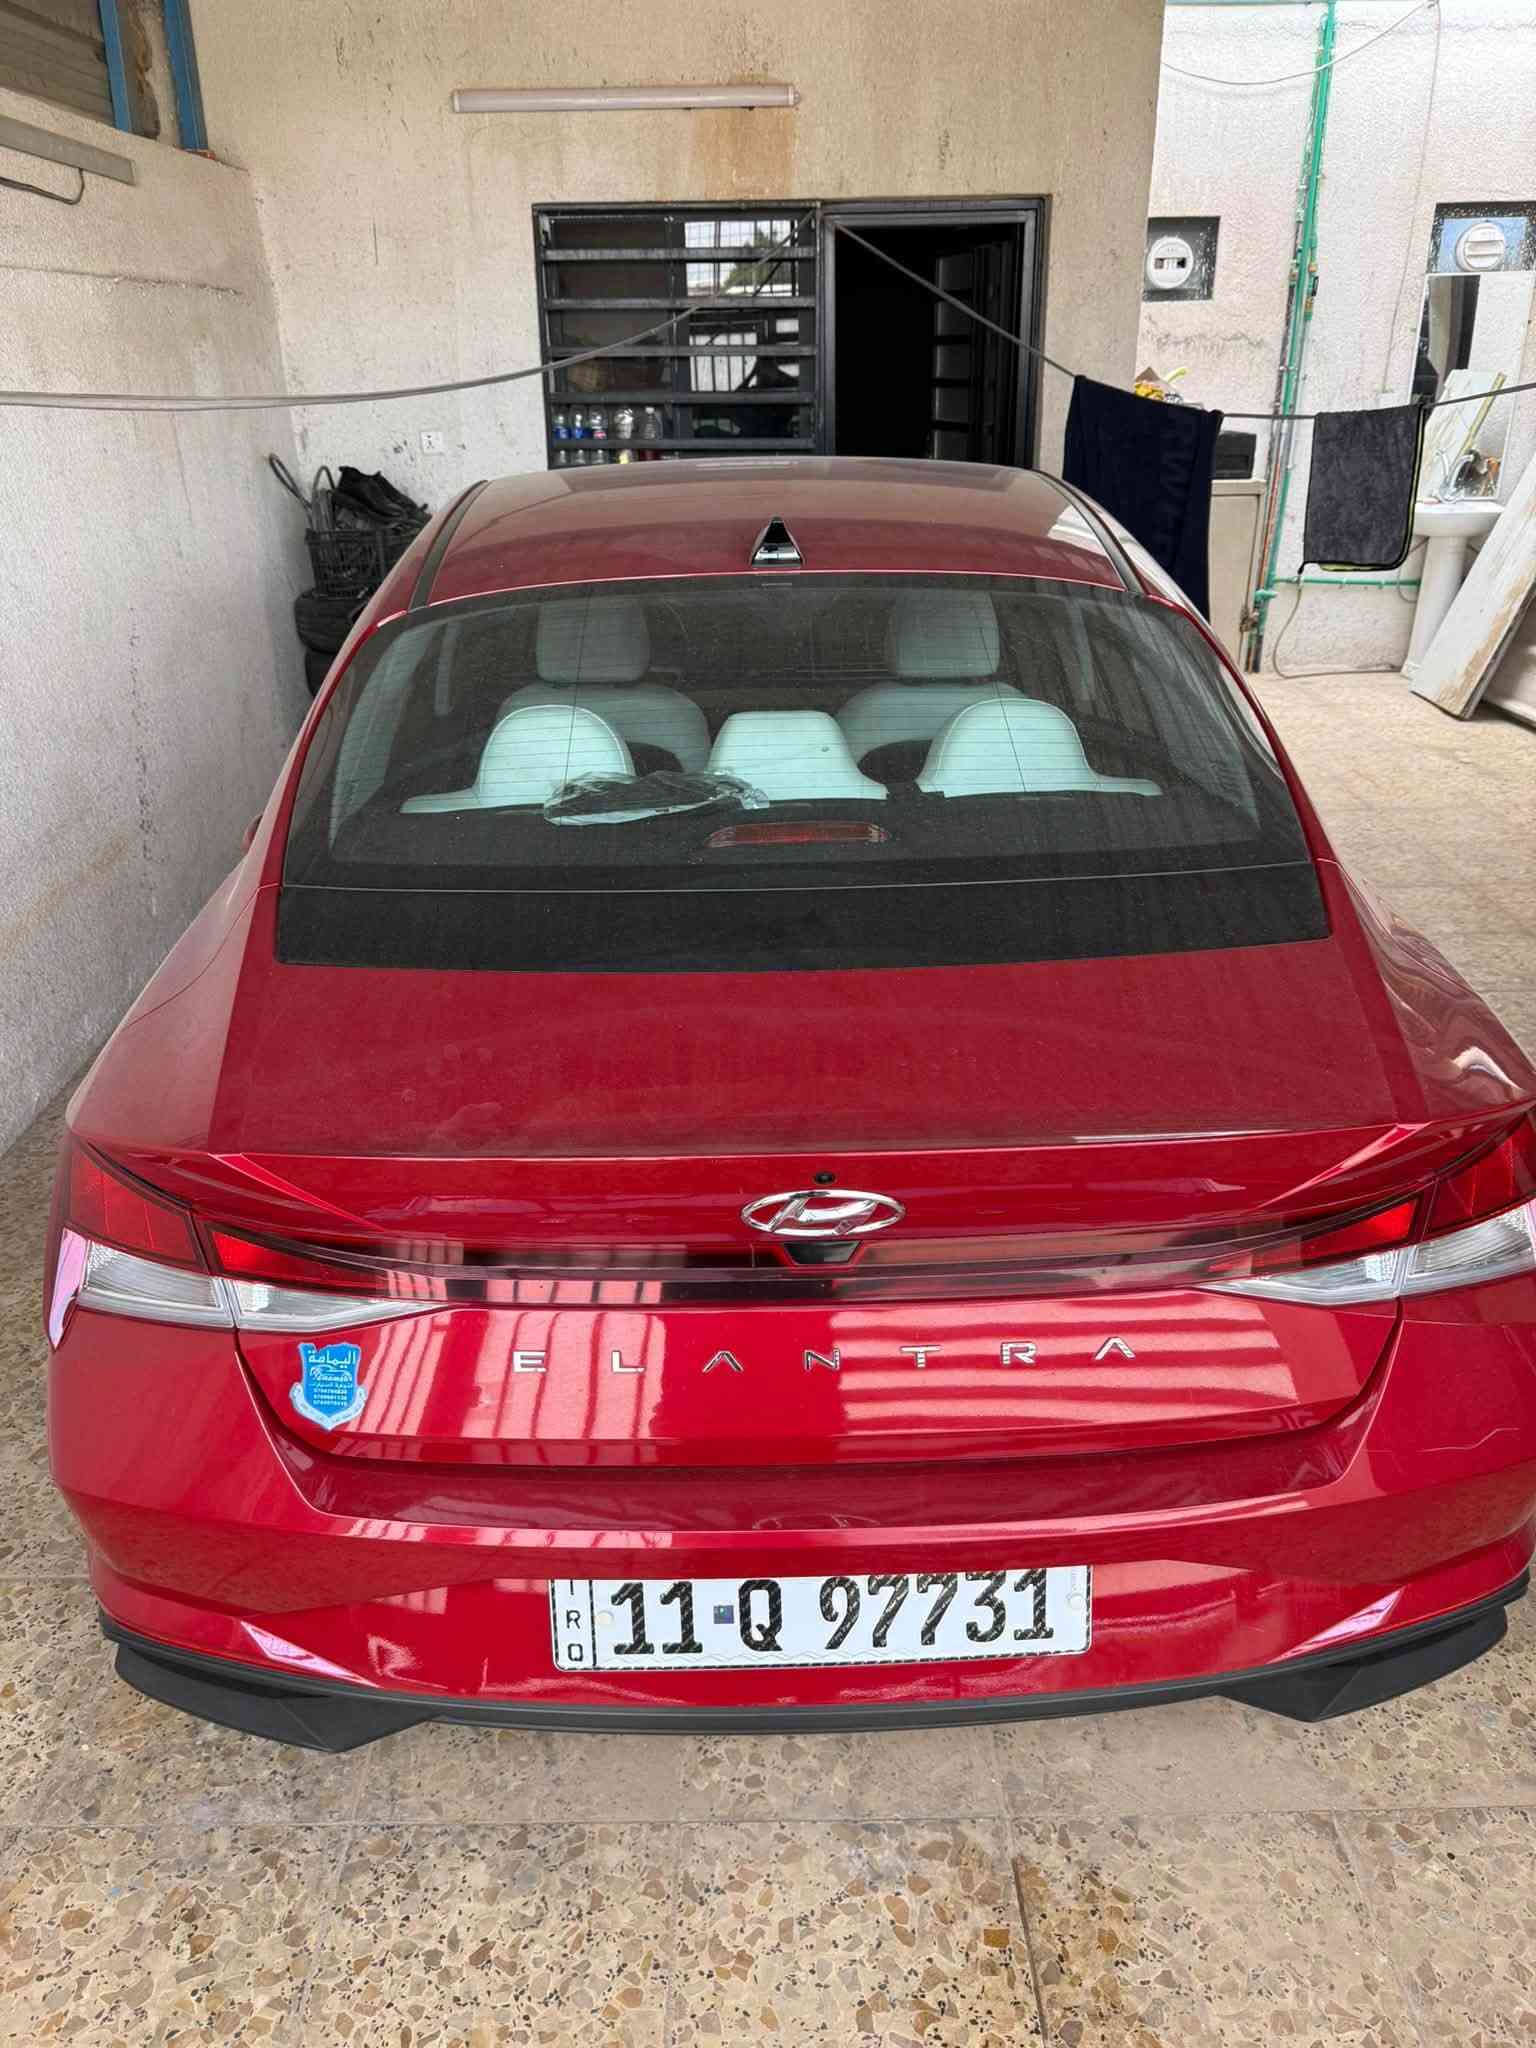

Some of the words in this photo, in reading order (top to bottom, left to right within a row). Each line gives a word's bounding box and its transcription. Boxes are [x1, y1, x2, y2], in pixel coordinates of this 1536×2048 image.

[308, 1349, 356, 1369] اليمامة
[513, 1336, 1136, 1373] ELANTRA
[611, 1580, 702, 1654] 11
[738, 1579, 782, 1651] Q
[819, 1568, 1054, 1650] 97731
